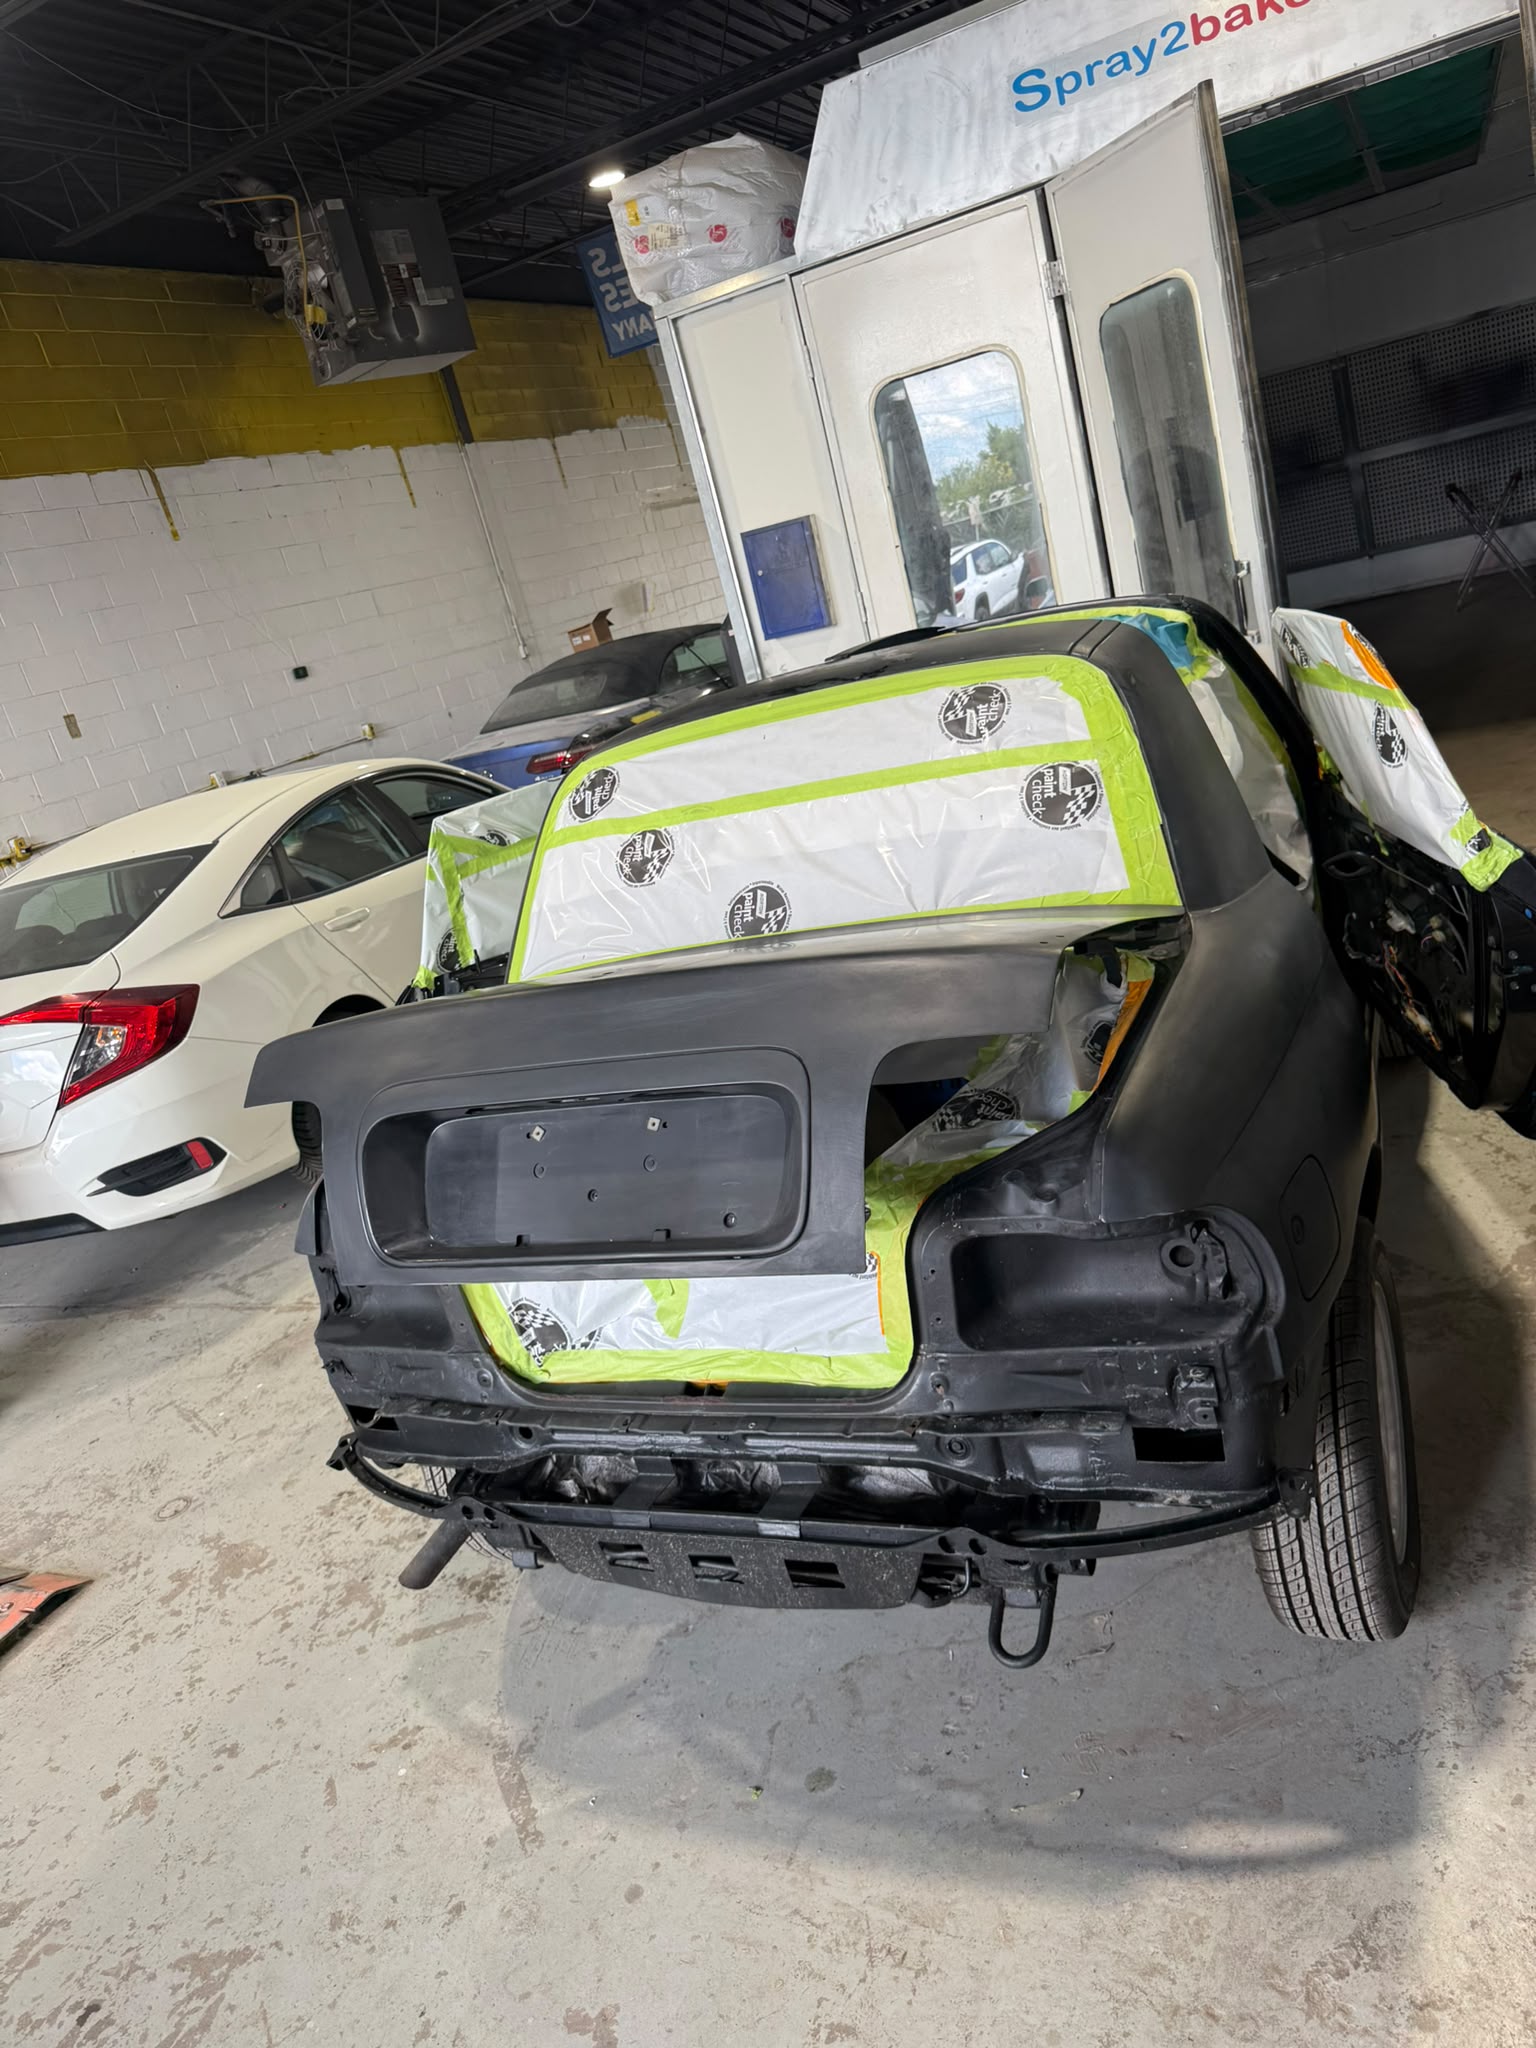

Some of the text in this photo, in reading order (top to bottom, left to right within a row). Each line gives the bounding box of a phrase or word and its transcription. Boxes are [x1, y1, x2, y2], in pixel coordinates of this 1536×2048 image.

[988, 689, 1001, 721] check
[592, 785, 603, 811] paint
[602, 773, 615, 800] check
[1032, 779, 1046, 817] check
[1040, 768, 1057, 799] paint
[623, 846, 635, 876] check
[733, 904, 745, 938] check
[742, 892, 755, 923] paint
